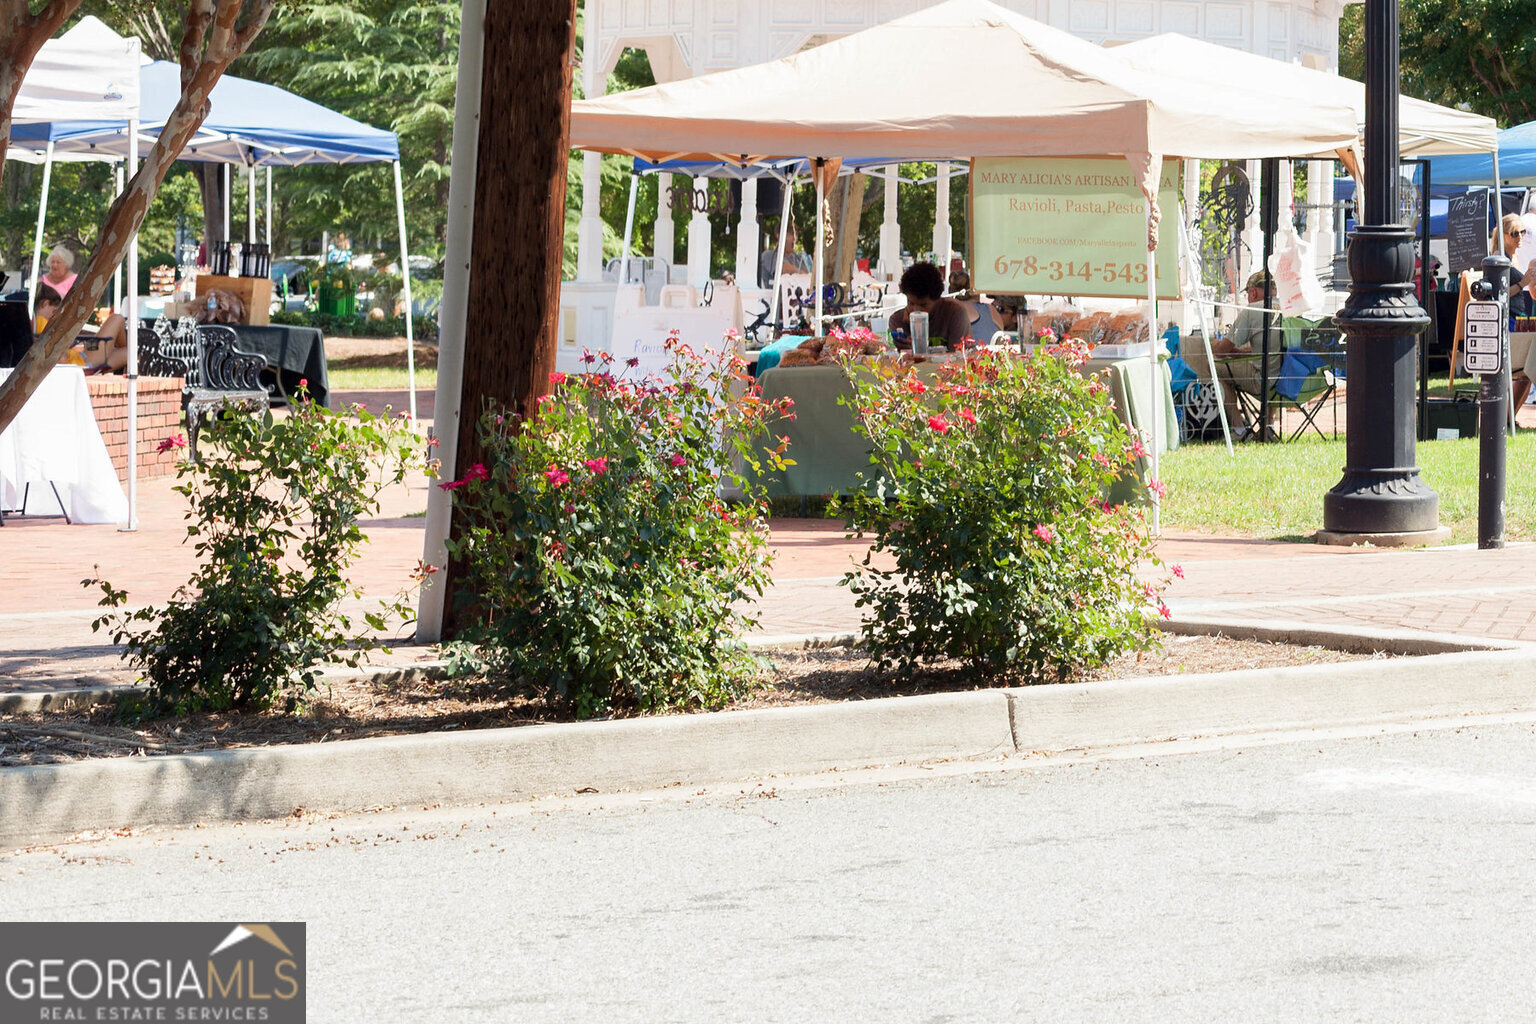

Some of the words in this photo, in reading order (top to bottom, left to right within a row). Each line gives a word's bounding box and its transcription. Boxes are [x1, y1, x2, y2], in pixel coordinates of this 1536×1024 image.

[981, 172, 1018, 185] MARY
[1019, 173, 1072, 186] ALICIA'S
[1075, 174, 1129, 187] ARTISAN
[1009, 197, 1062, 214] Ravioli,
[1450, 193, 1486, 215] Thirsty?
